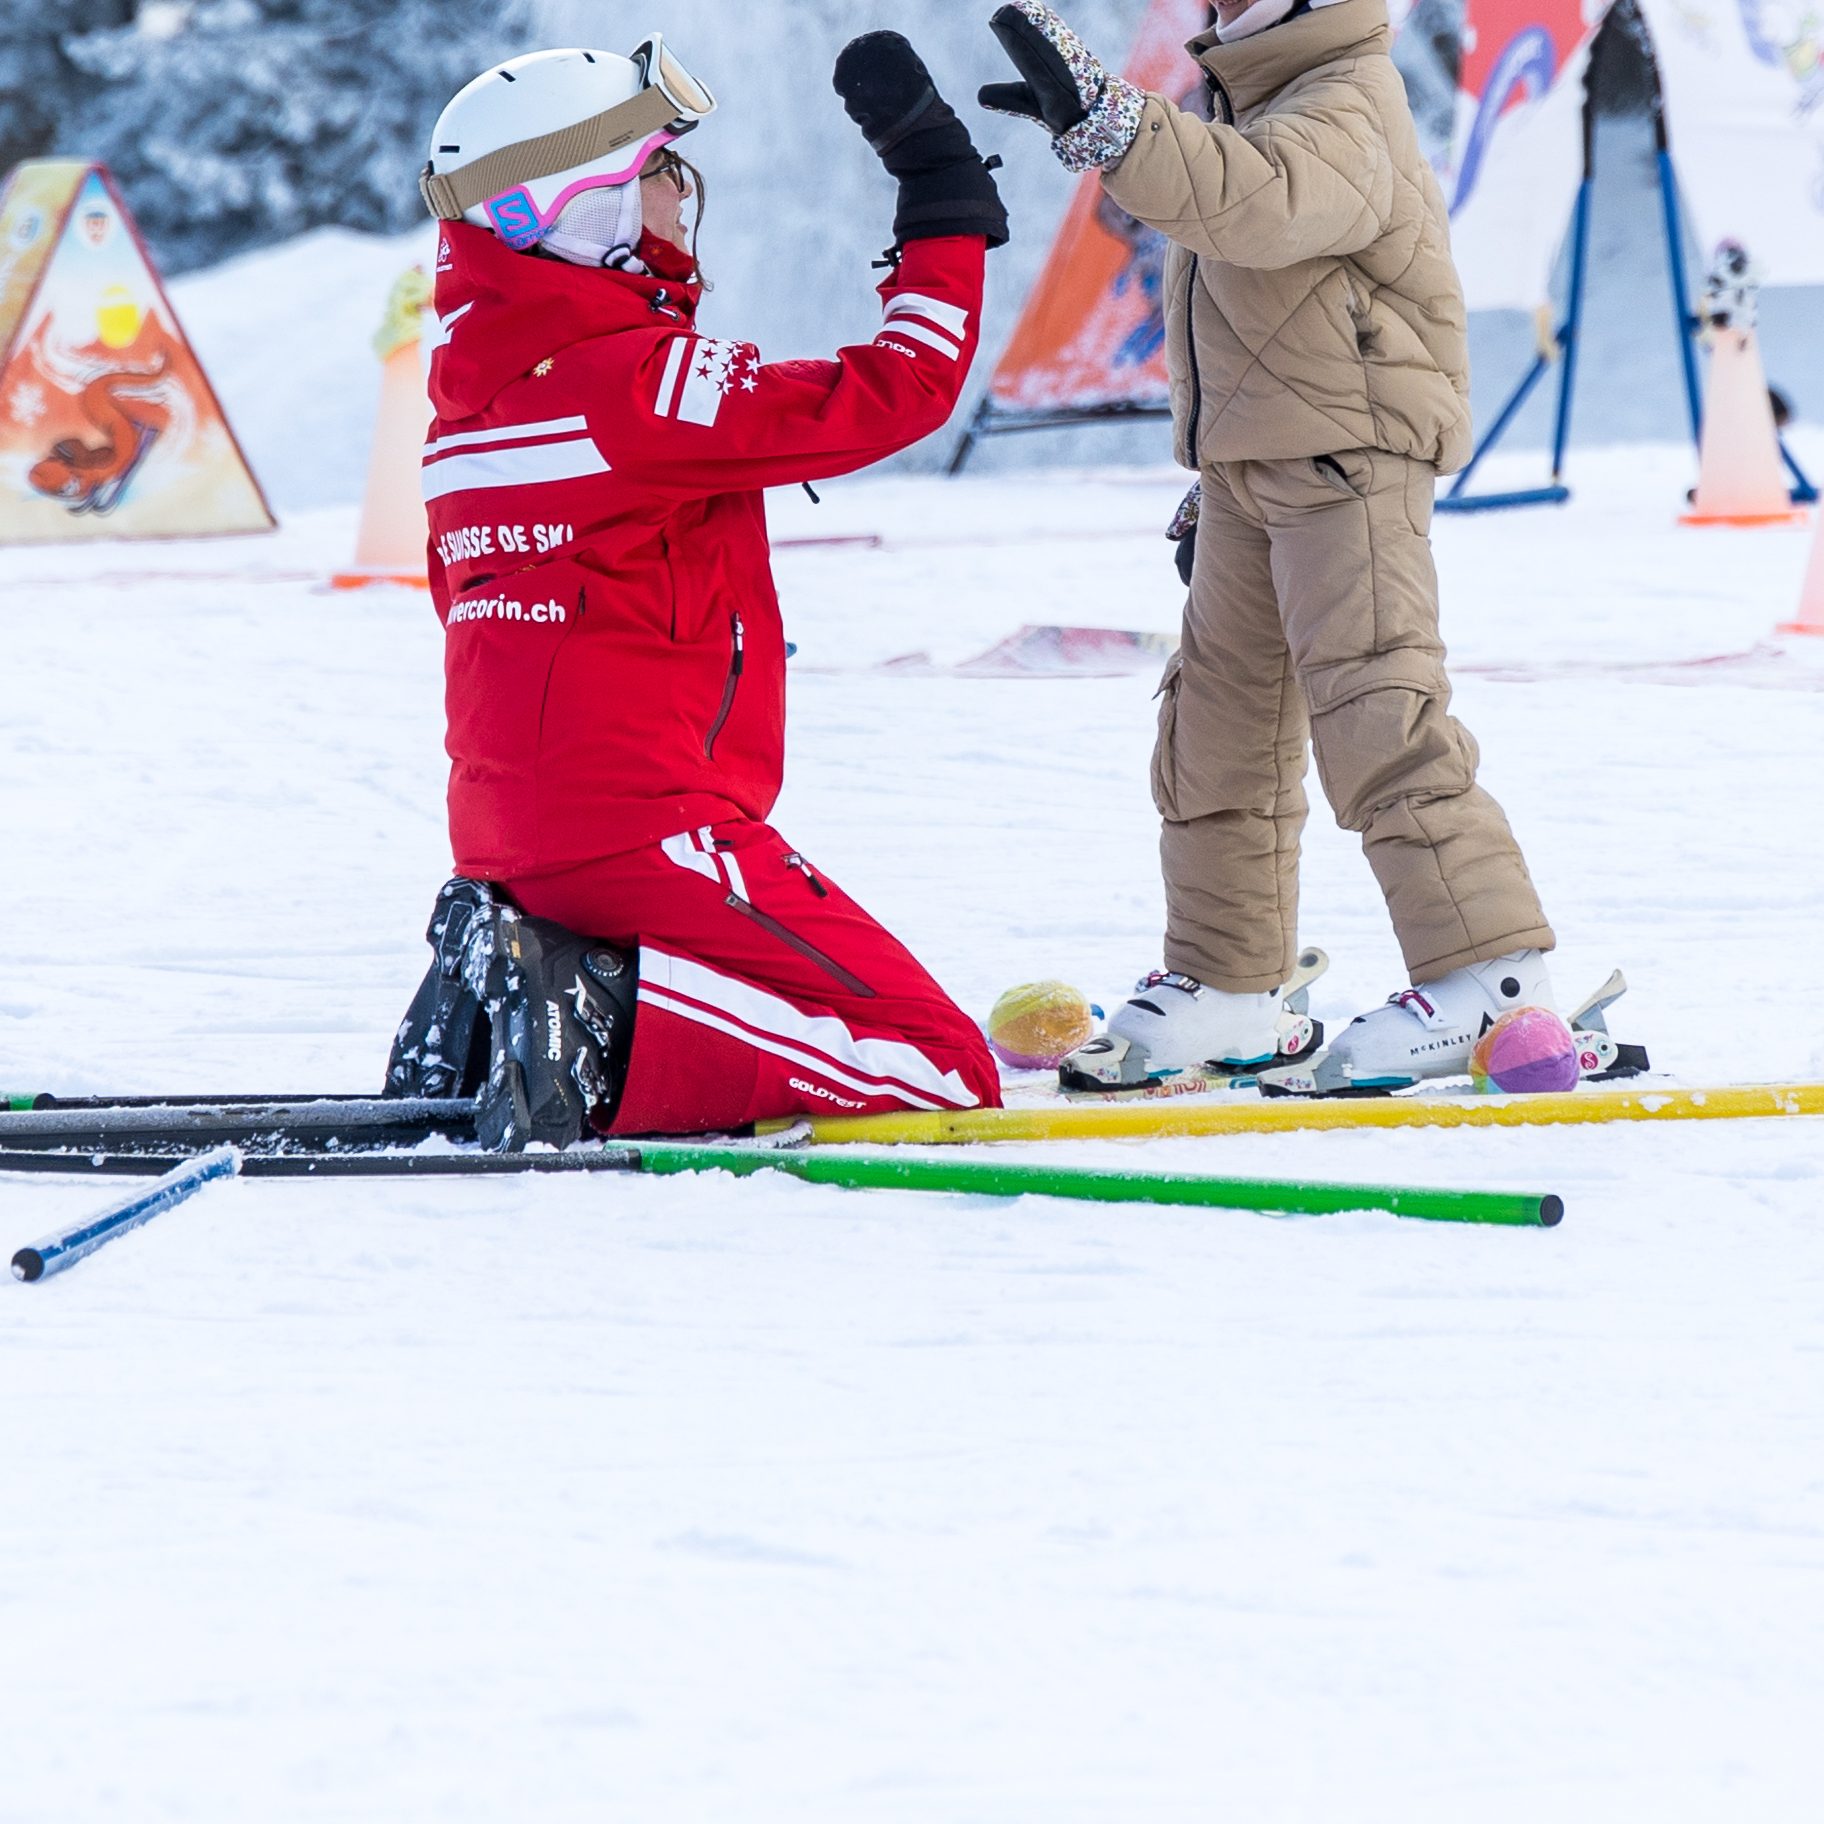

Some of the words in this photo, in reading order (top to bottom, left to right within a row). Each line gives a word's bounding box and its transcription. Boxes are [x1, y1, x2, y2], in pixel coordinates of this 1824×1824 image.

[446, 525, 496, 563] SUISSE
[497, 525, 531, 552] DE
[533, 523, 574, 553] SKI
[545, 999, 562, 1062] ATOMIC
[788, 1077, 868, 1110] GOLDTEST
